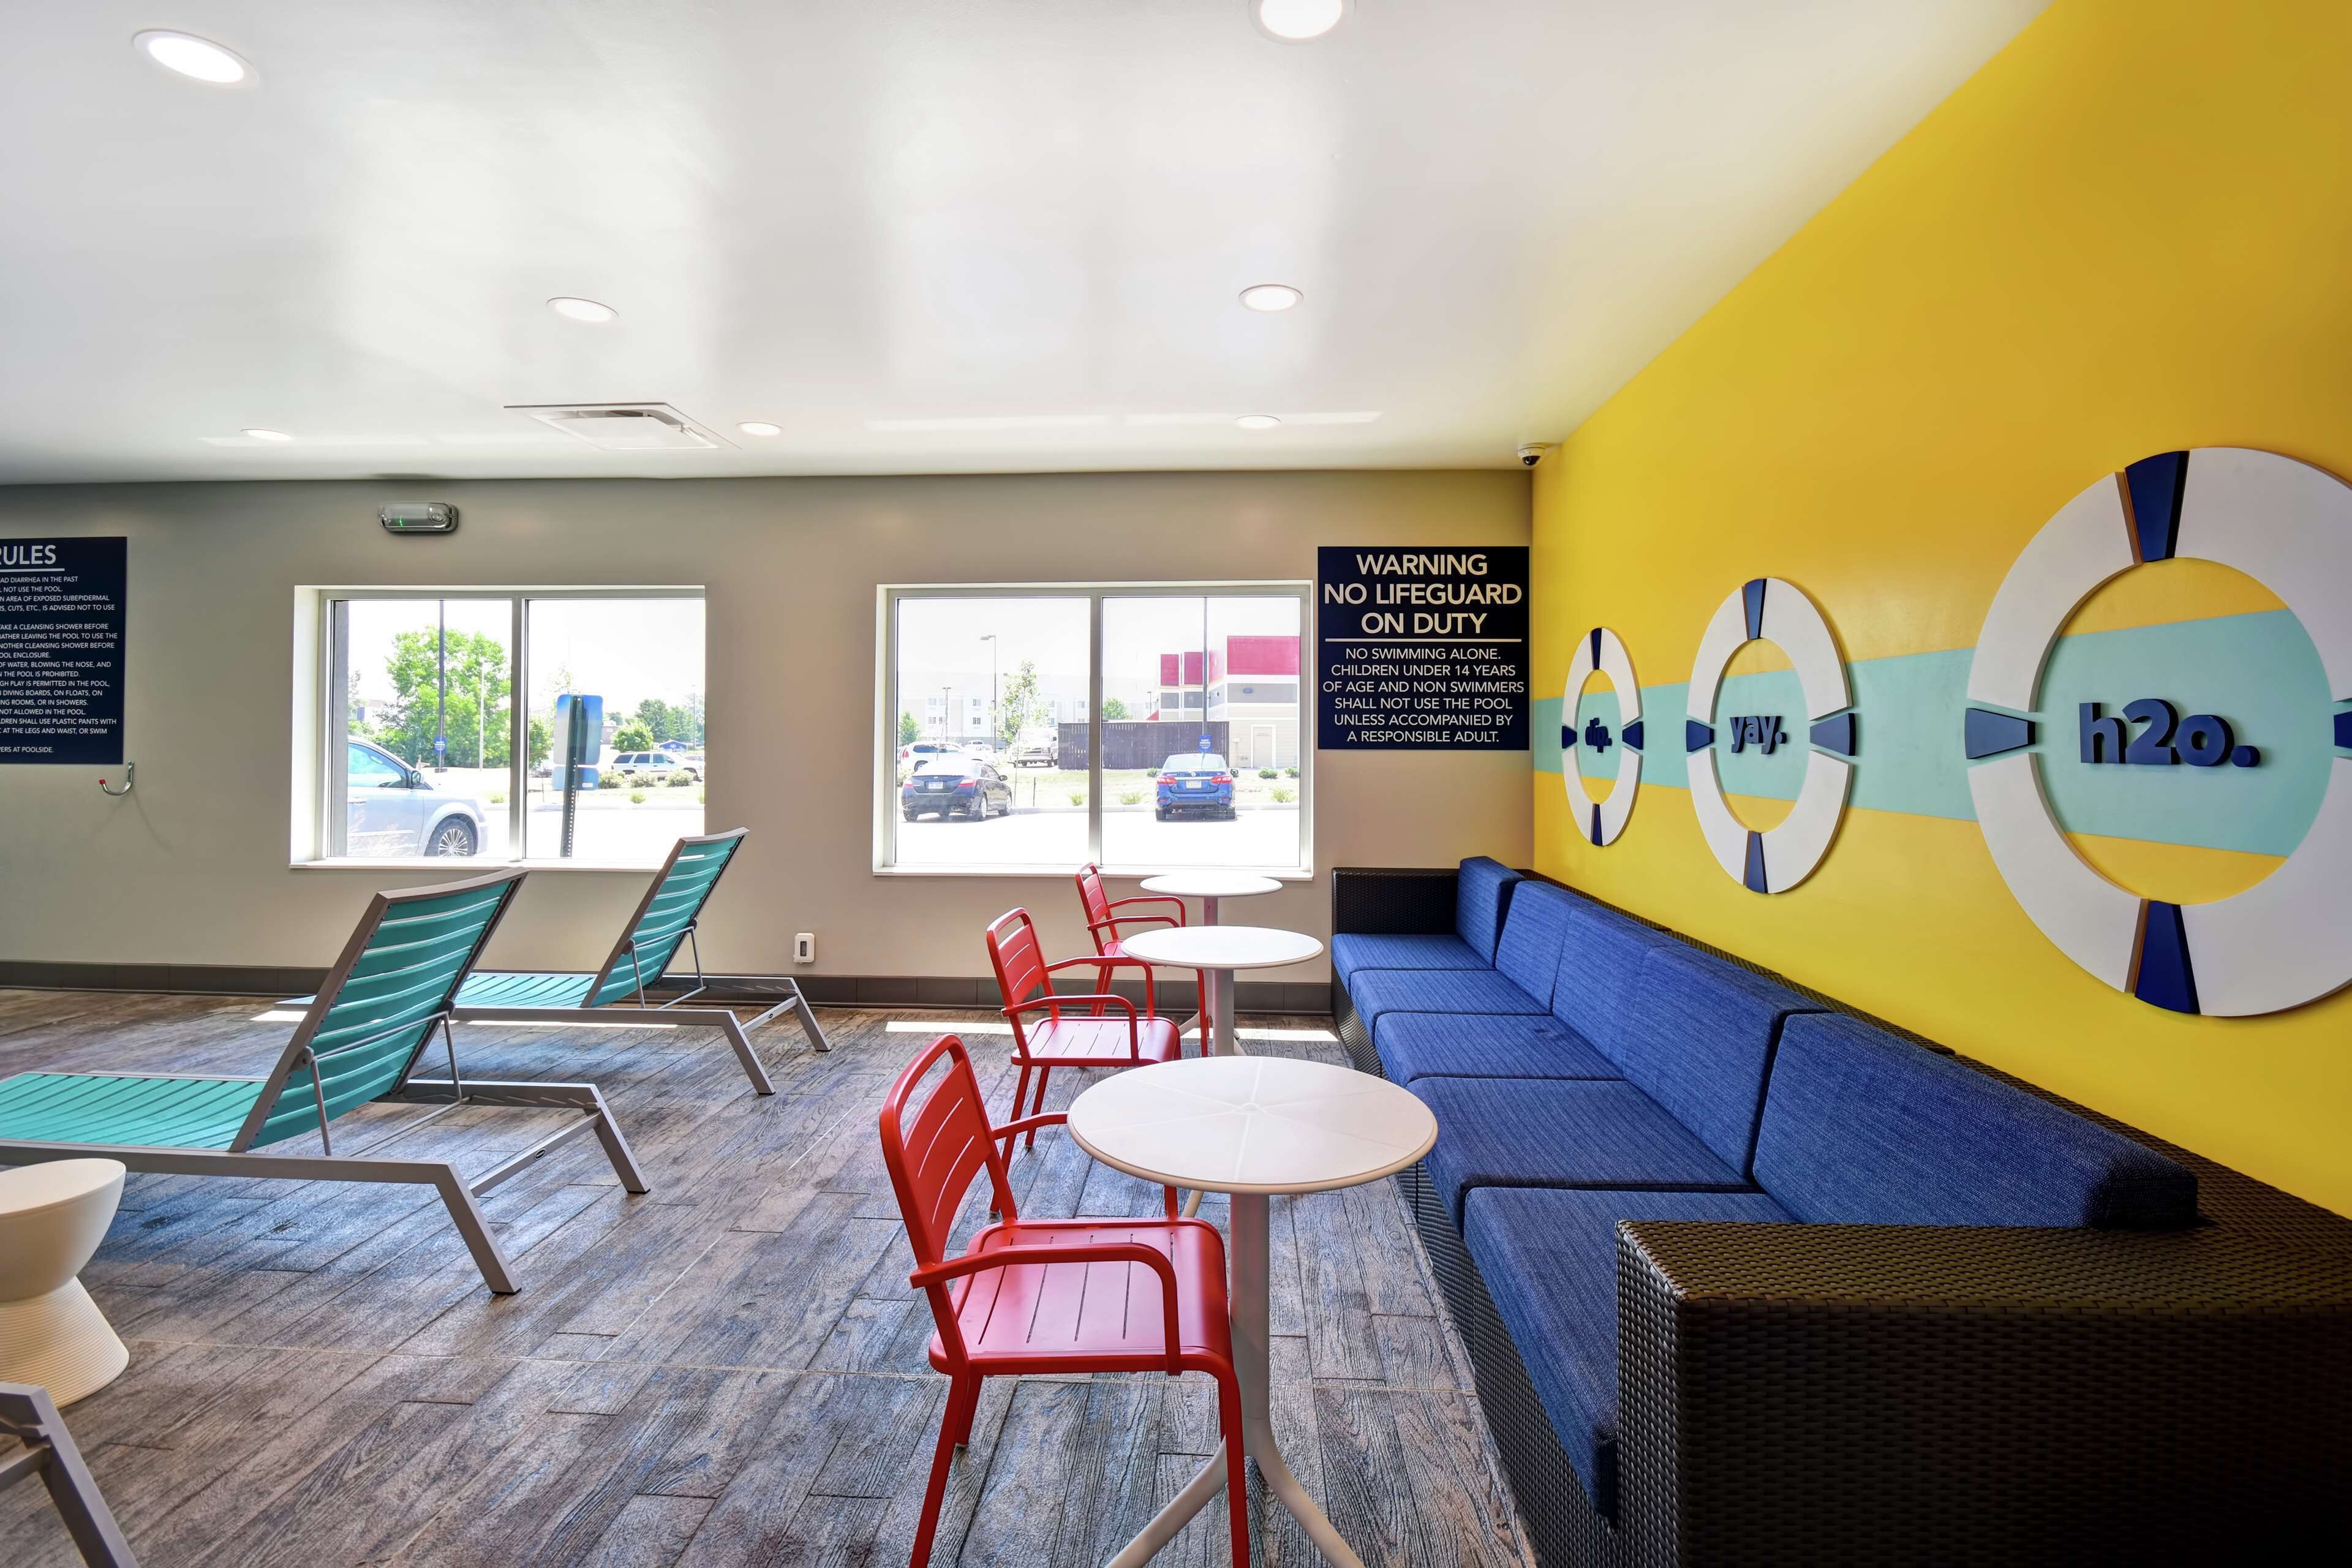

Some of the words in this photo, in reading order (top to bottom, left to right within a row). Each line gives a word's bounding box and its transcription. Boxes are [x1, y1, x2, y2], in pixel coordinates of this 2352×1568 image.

[0, 545, 56, 565] ULES
[1356, 554, 1488, 575] WARNING
[1324, 583, 1367, 605] NO
[1376, 583, 1522, 605] LIFEGUARD
[1361, 612, 1404, 634] ON
[1414, 612, 1487, 634] DUTY
[1346, 648, 1368, 660] NO
[1371, 648, 1446, 660] SWIMMING
[1450, 648, 1501, 660] ALONE.
[1331, 664, 1399, 676] CHILDREN
[1403, 664, 1450, 676] UNDER
[1455, 665, 1469, 676] 14
[1473, 665, 1516, 676] YEARS
[1322, 680, 1343, 693] OF
[1346, 680, 1374, 693] AGE
[1378, 681, 1409, 693] AND
[1413, 681, 1446, 693] NON
[1450, 681, 1524, 693] SWIMMERS
[1335, 698, 1376, 709] SHALL
[1381, 698, 1411, 709] NOT
[1414, 698, 1439, 709] USE
[1443, 698, 1470, 709] THE
[1474, 698, 1512, 709] POOL
[1335, 714, 1385, 726] UNLESS
[1389, 714, 1491, 726] ACCOMPANIED
[1496, 715, 1513, 726] BY
[1347, 731, 1357, 742] A
[1361, 731, 1450, 742] RESPONSIBLE
[1454, 731, 1499, 742] ADULT.
[1585, 718, 1612, 753] dip.
[1730, 716, 1787, 755] yay.
[2079, 698, 2260, 767] h2o.
